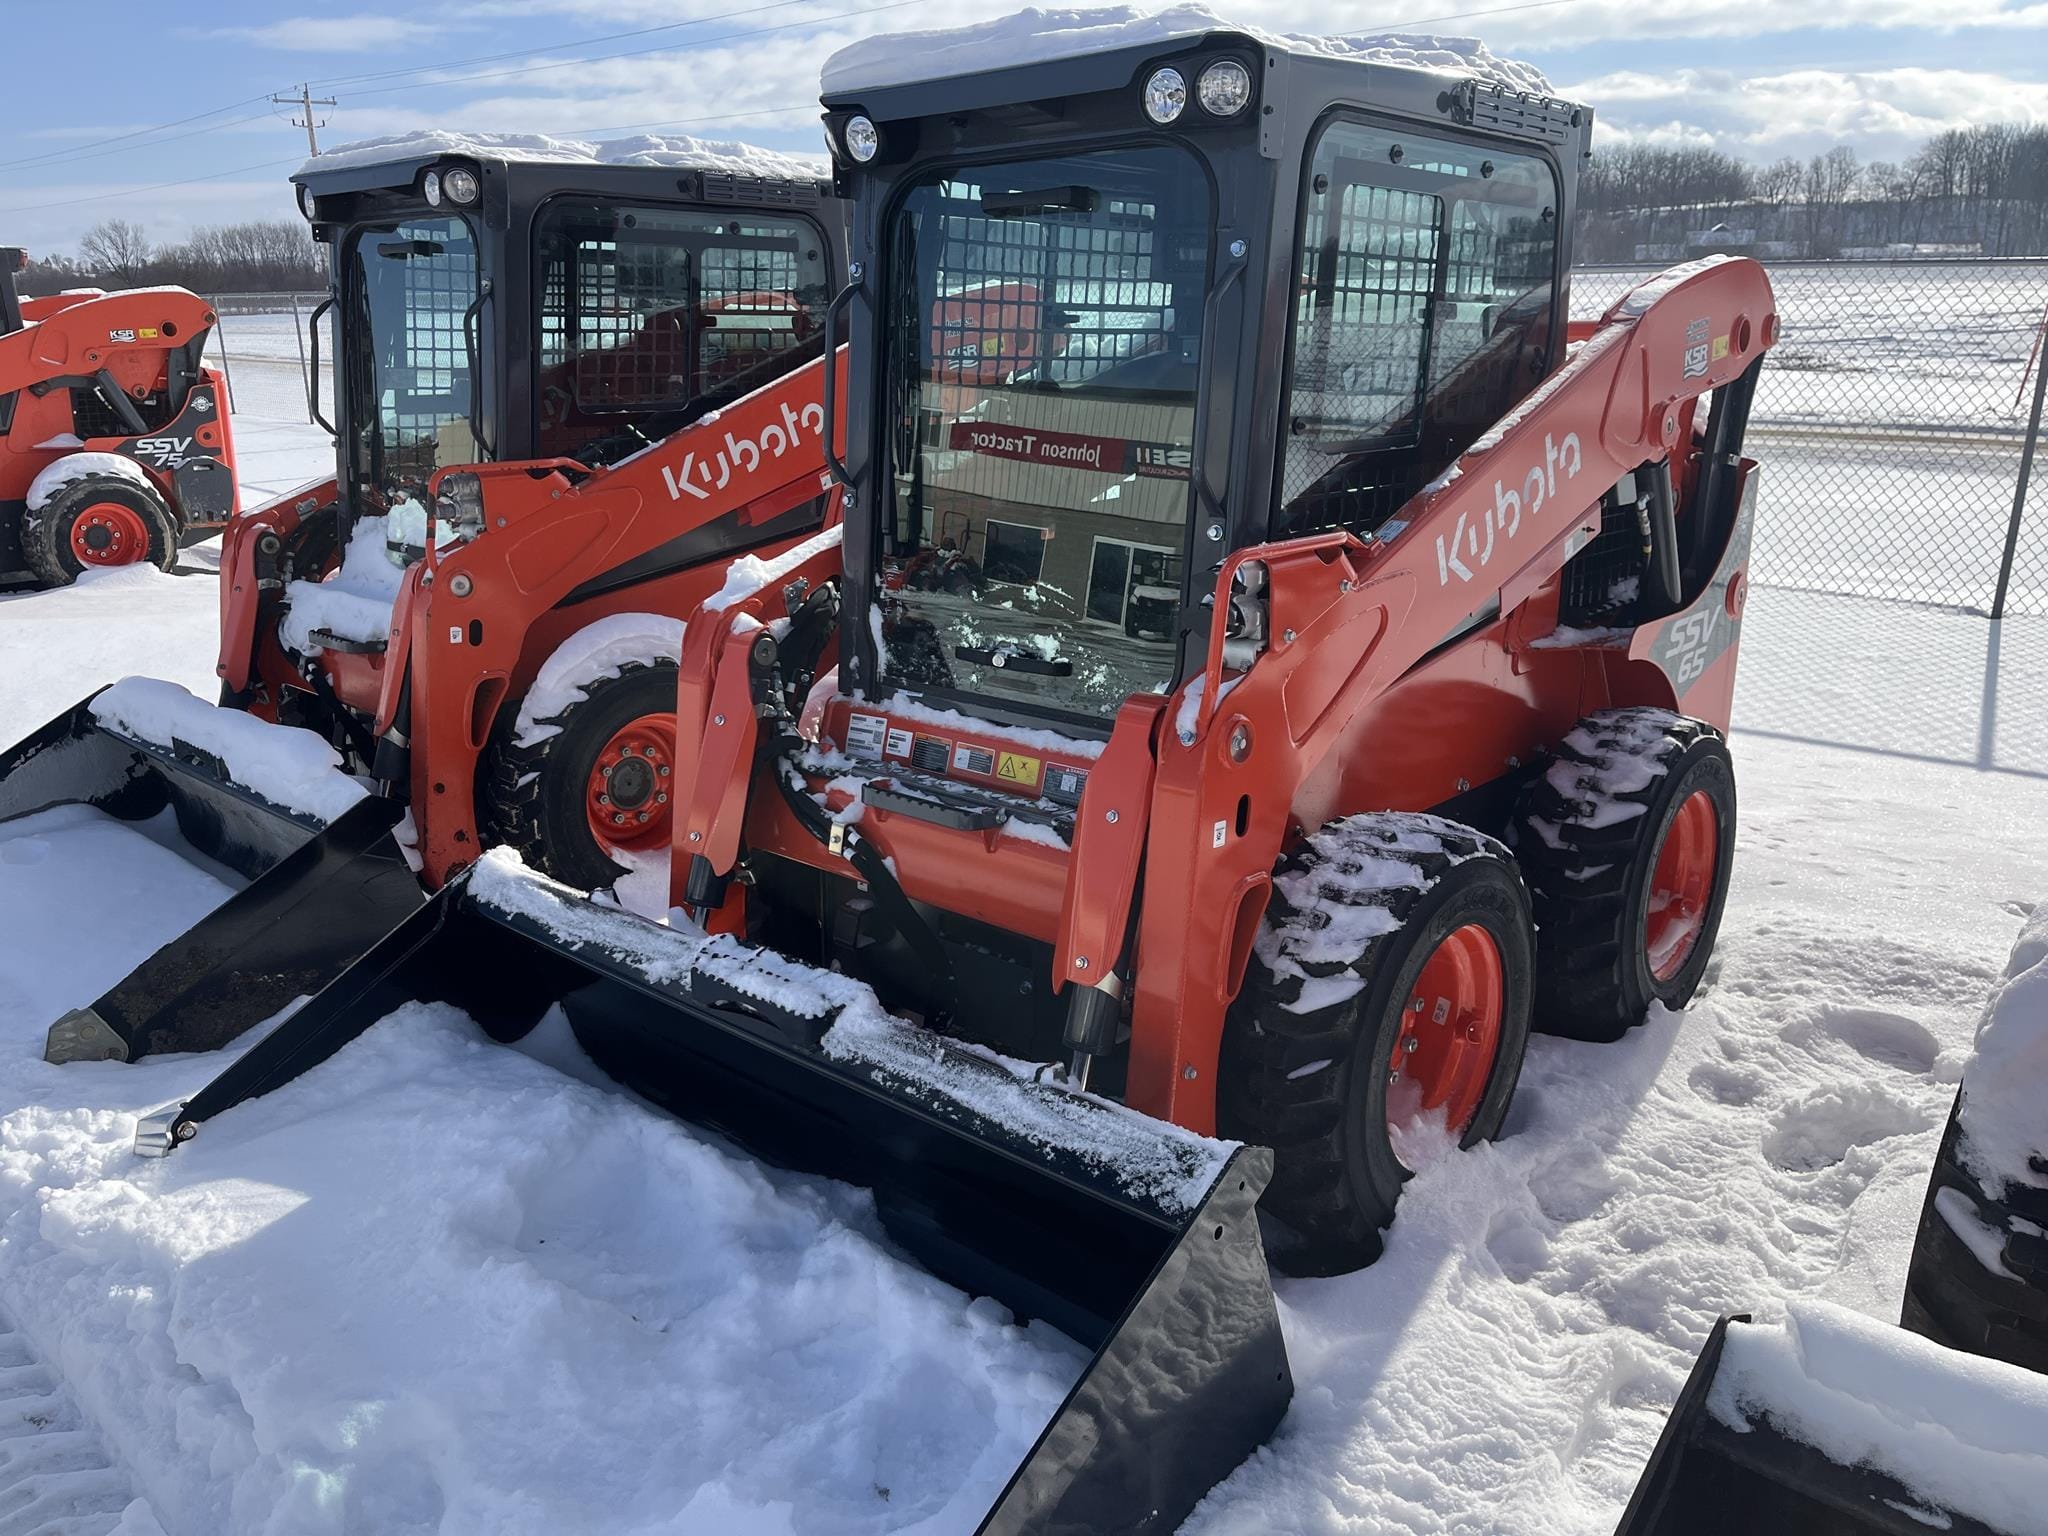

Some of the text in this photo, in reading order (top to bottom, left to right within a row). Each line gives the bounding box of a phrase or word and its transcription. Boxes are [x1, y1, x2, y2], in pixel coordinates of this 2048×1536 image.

[109, 329, 135, 339] KSR
[1684, 343, 1708, 367] KSR
[134, 436, 193, 454] SSV
[661, 401, 824, 501] Kubota
[1435, 432, 1582, 587] Kubota
[1664, 604, 1722, 660] SSV
[1677, 645, 1708, 684] 65
